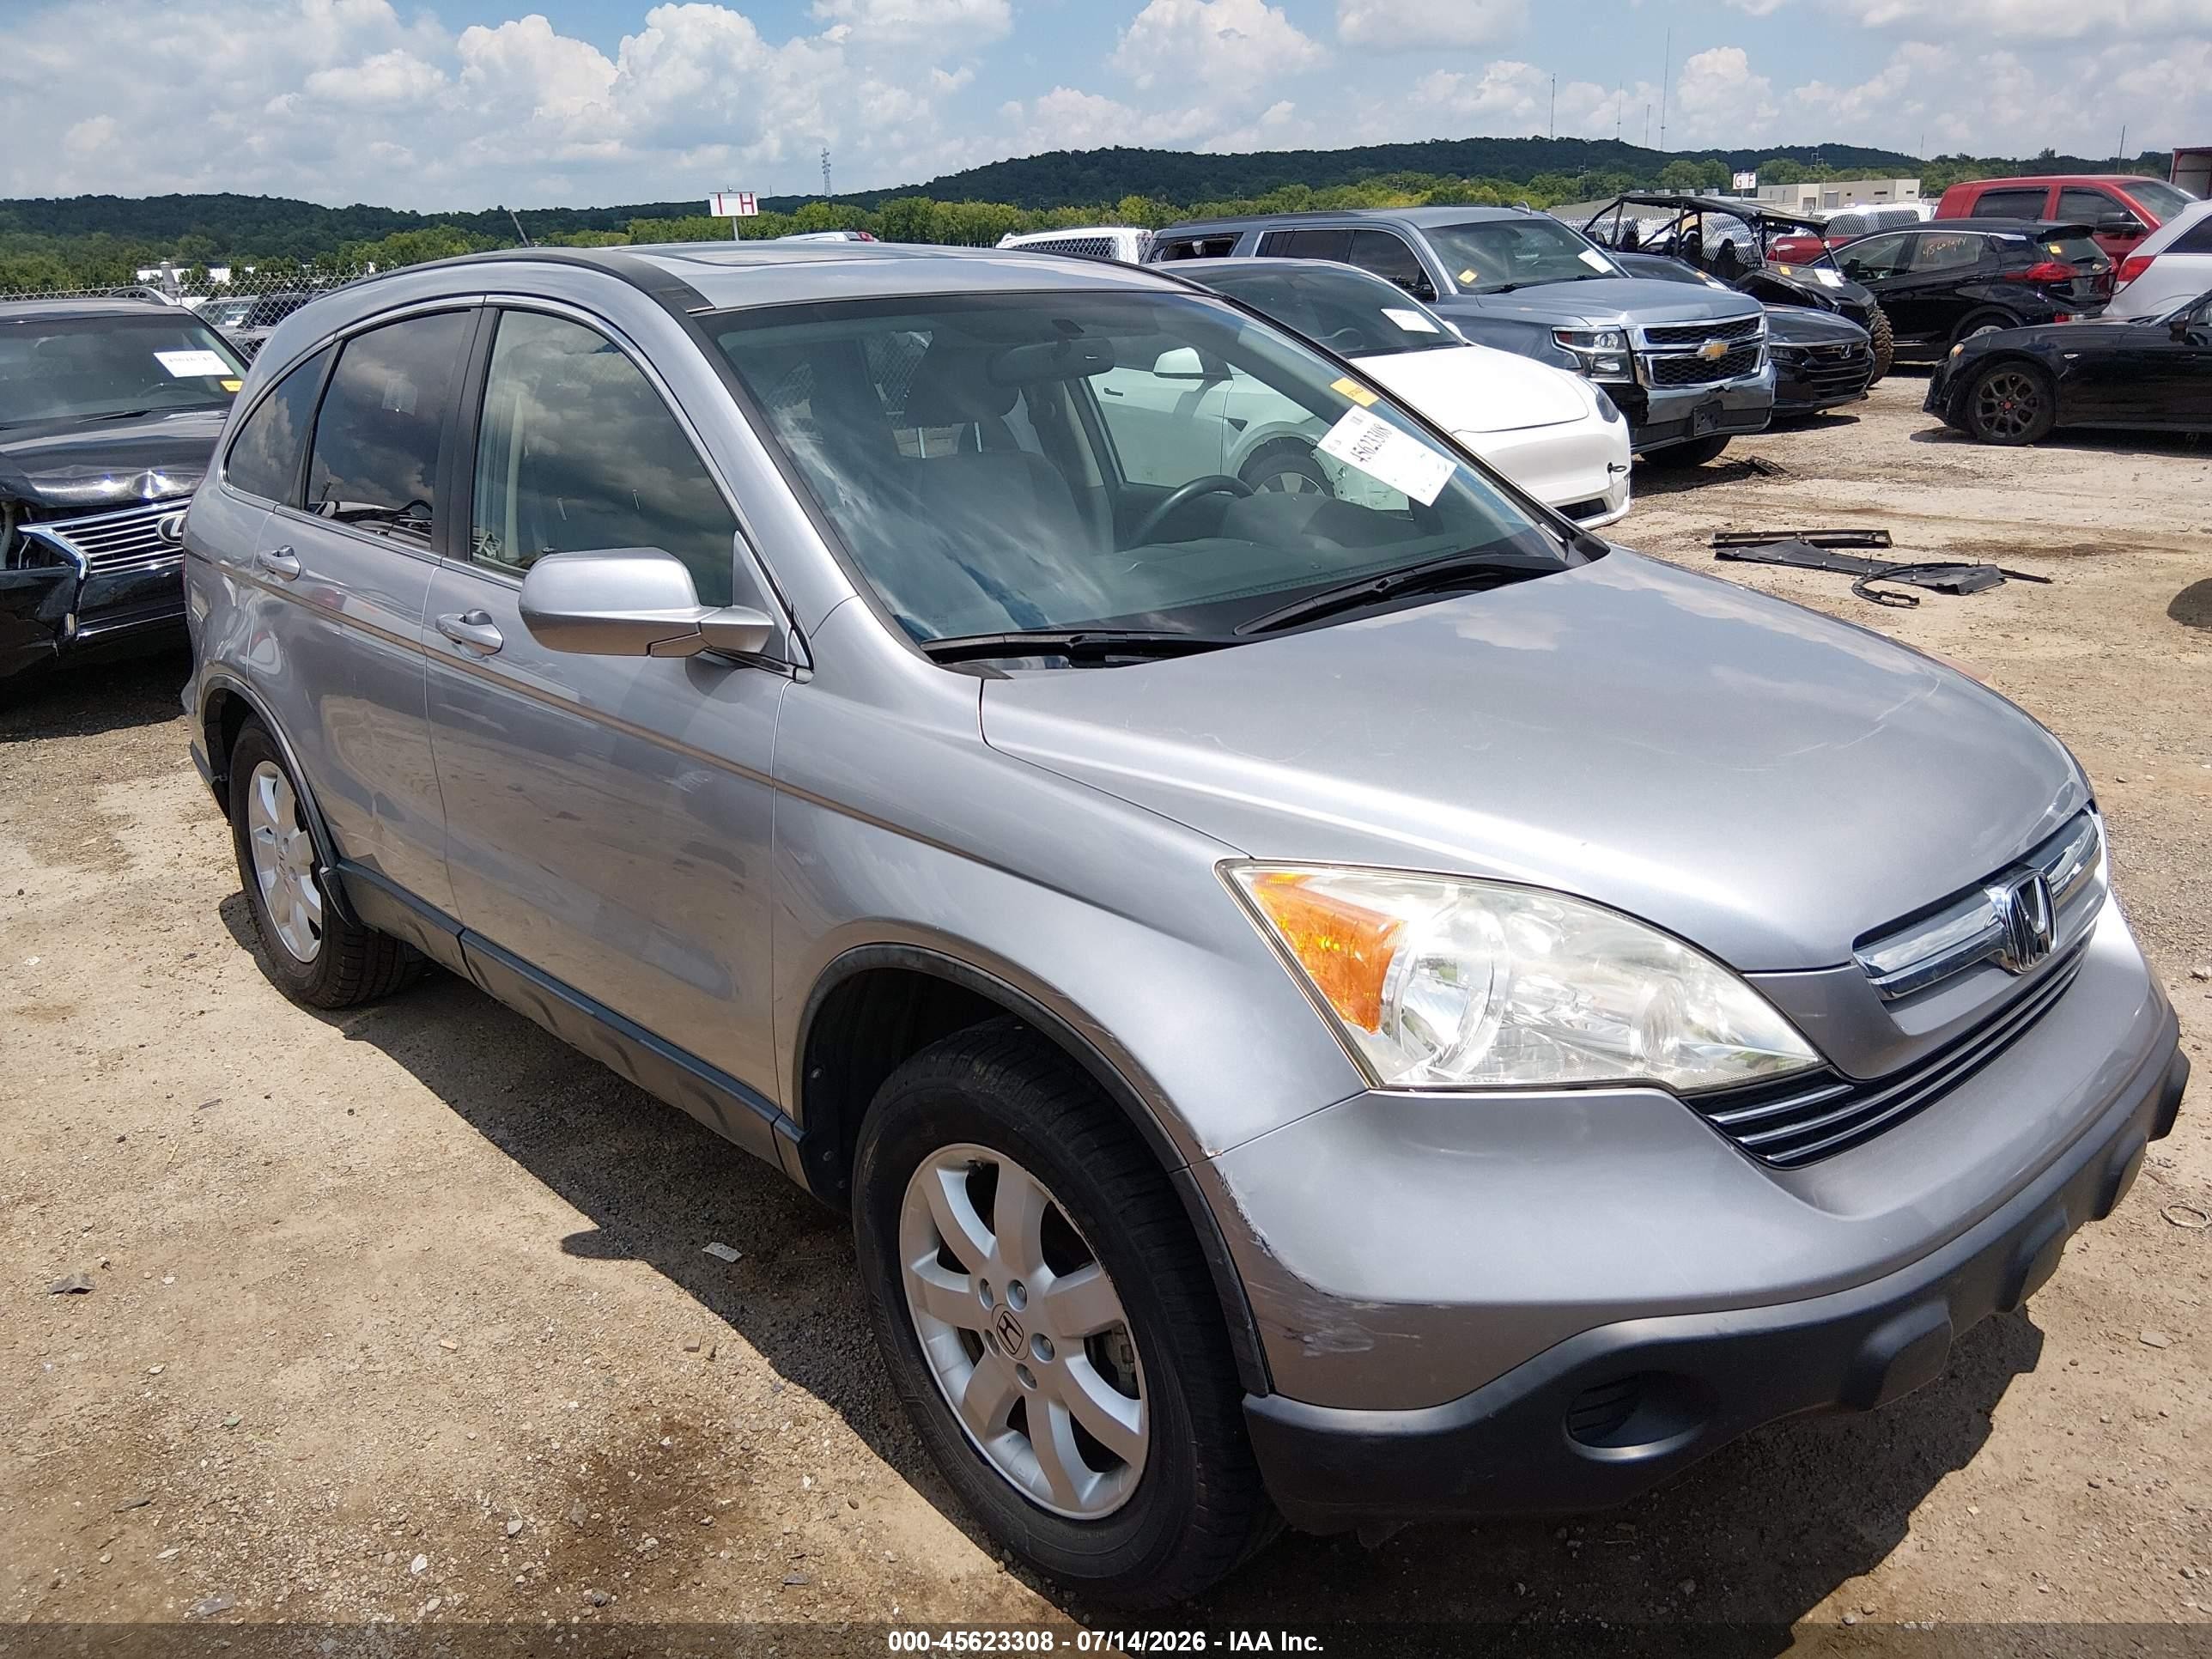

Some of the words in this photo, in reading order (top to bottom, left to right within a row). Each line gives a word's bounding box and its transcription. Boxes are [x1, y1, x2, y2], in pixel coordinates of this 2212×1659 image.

[1735, 173, 1742, 188] G
[1748, 173, 1754, 188] F
[739, 193, 755, 215] H
[1350, 422, 1393, 464] 45623308
